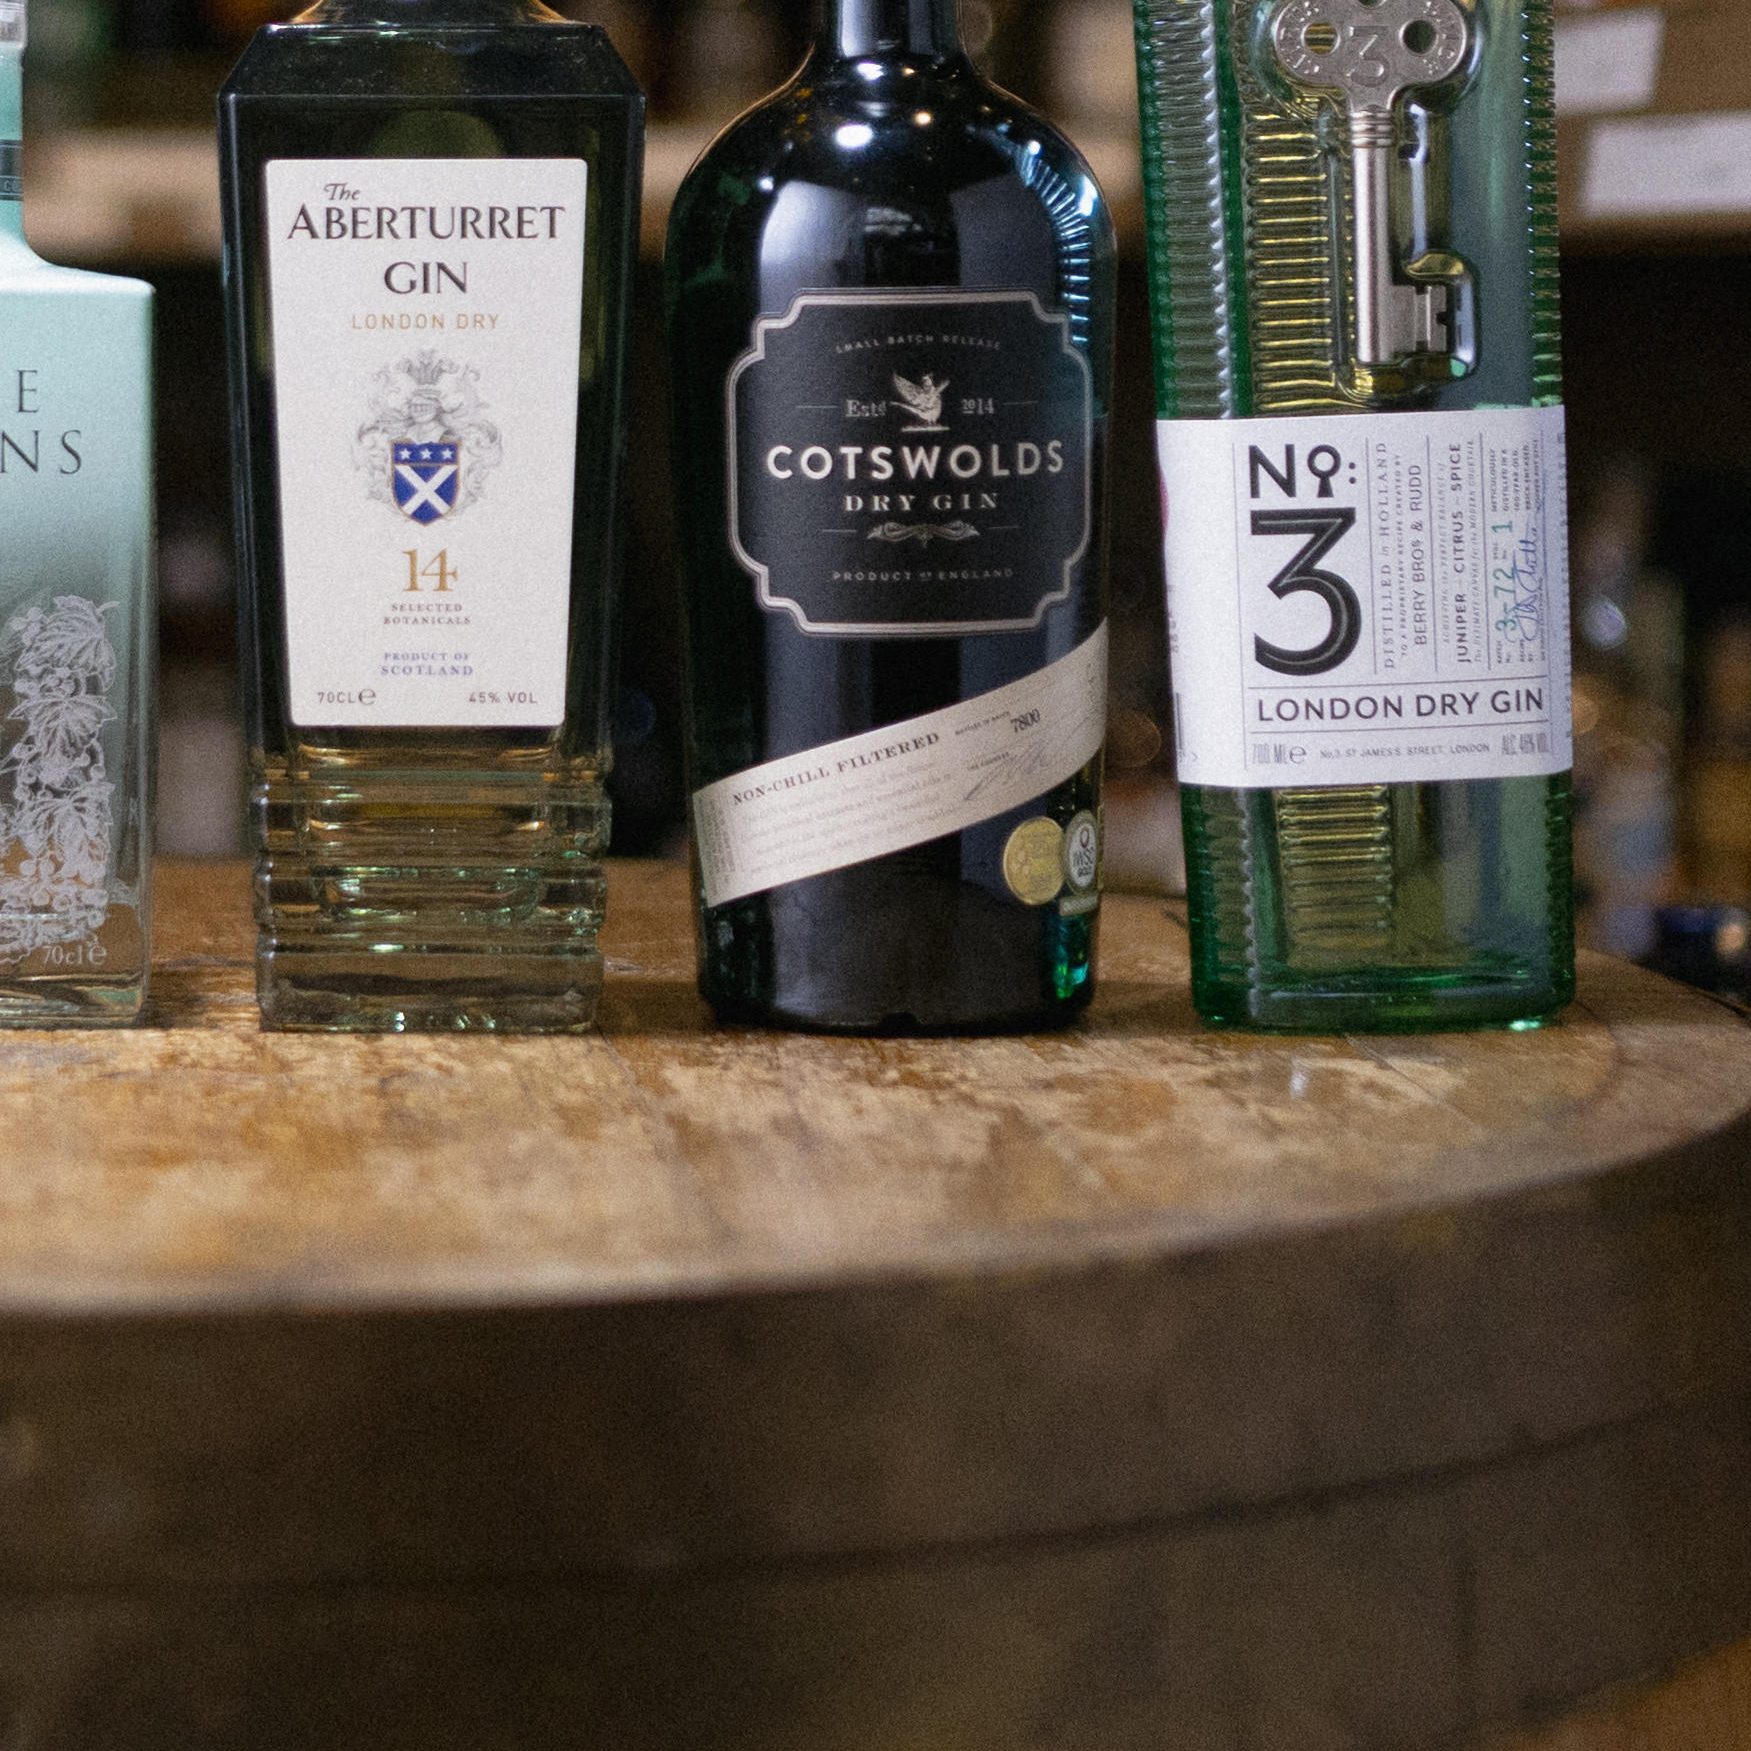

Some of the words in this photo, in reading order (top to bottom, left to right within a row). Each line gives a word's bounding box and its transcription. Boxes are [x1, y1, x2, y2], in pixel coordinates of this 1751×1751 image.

[1347, 24, 1390, 88] 3
[323, 182, 361, 201] The
[286, 203, 567, 240] ABERTURRET
[383, 261, 468, 295] GIN
[351, 313, 445, 330] LONDON
[456, 313, 498, 330] DRY
[888, 335, 934, 345] BATCH
[766, 439, 1064, 481] COTSWOLDS
[1448, 443, 1462, 493] SPICE
[845, 494, 916, 512] DRY
[932, 492, 999, 511] GIN
[1375, 441, 1391, 538] HOLLAND
[1408, 464, 1423, 512] RUDD
[1410, 519, 1424, 532] &
[1451, 510, 1465, 574] CITRUS
[401, 548, 459, 592] 14
[832, 570, 912, 581] PRODUCT
[938, 568, 1014, 580] ENGLAND
[391, 603, 463, 613] SELECTED
[1249, 506, 1363, 677] 3
[383, 616, 471, 626] BOTANICALS
[1379, 563, 1396, 670] DISTILLED
[1412, 590, 1428, 646] BERRY
[1454, 593, 1473, 664] JUNIPER
[379, 664, 474, 676] SCOTLAND
[383, 652, 448, 661] PRODUCT
[453, 652, 469, 661] OF
[468, 691, 501, 704] 45%
[507, 691, 539, 704] VOL
[1258, 694, 1403, 722] LONDON
[1415, 691, 1480, 718] DRY
[1490, 687, 1544, 714] GIN
[731, 767, 831, 806] NON-CHILL
[836, 731, 941, 774] FILTERED
